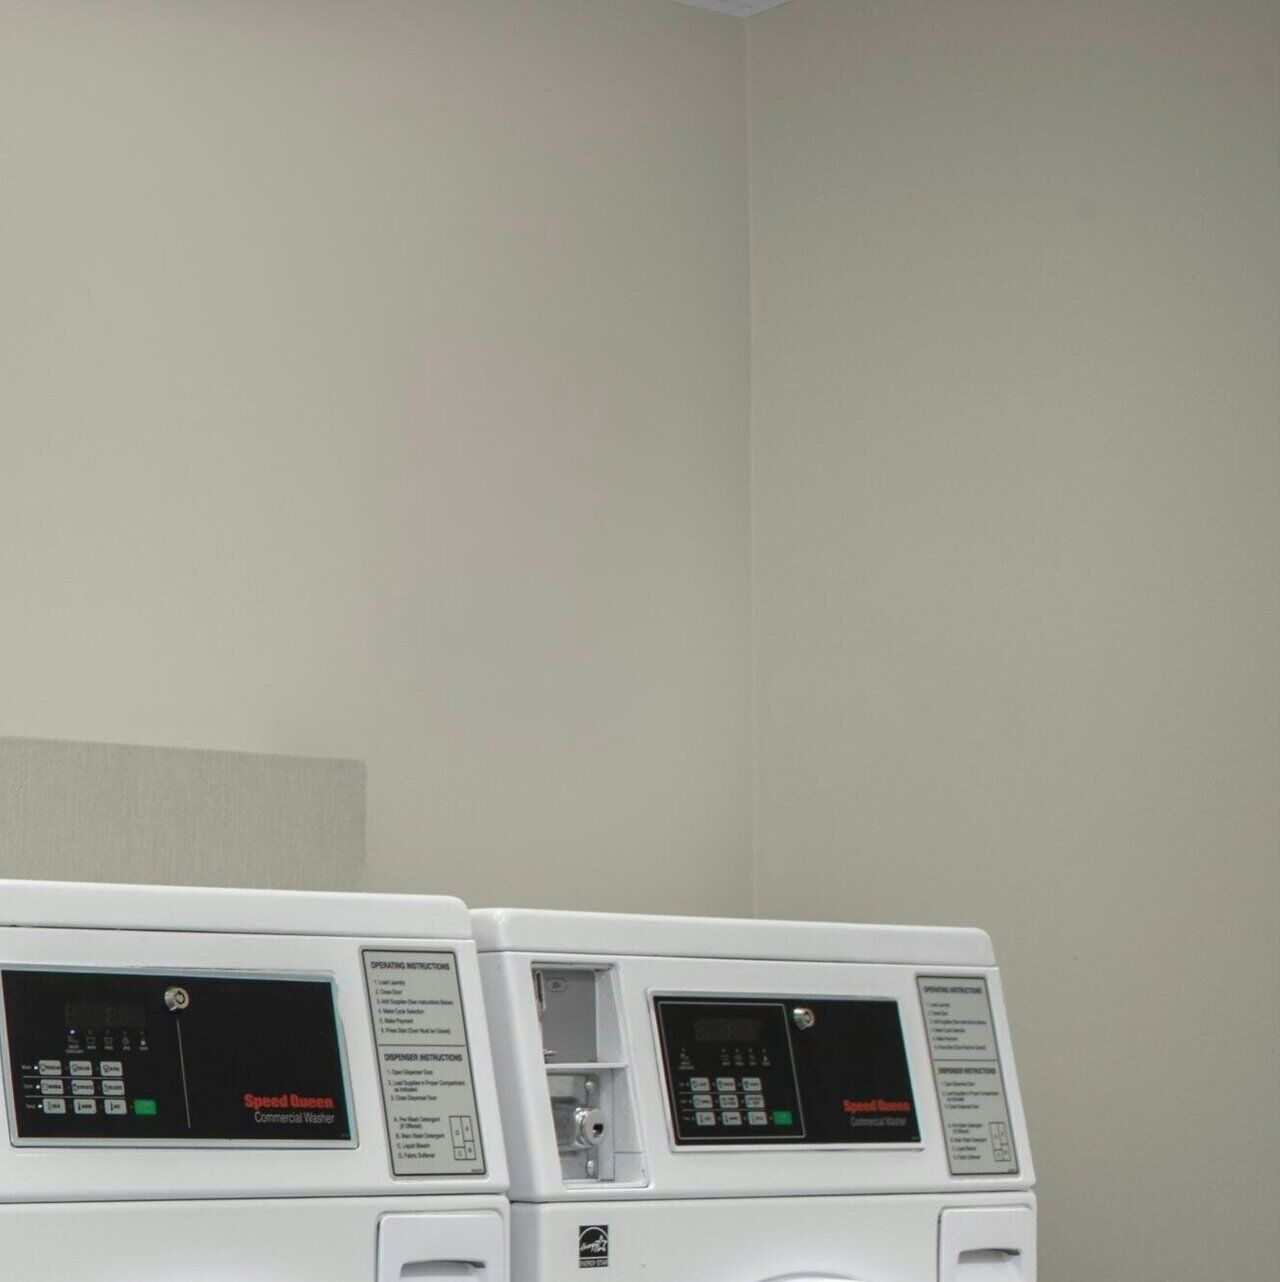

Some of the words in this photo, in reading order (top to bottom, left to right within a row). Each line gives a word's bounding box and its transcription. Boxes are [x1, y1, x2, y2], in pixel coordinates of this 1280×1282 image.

[244, 1094, 287, 1110] Speed
[291, 1094, 334, 1108] Queen
[843, 1100, 876, 1112] Speed
[878, 1101, 911, 1111] Queen
[255, 1112, 305, 1123] Commercial
[307, 1112, 334, 1123] Washer
